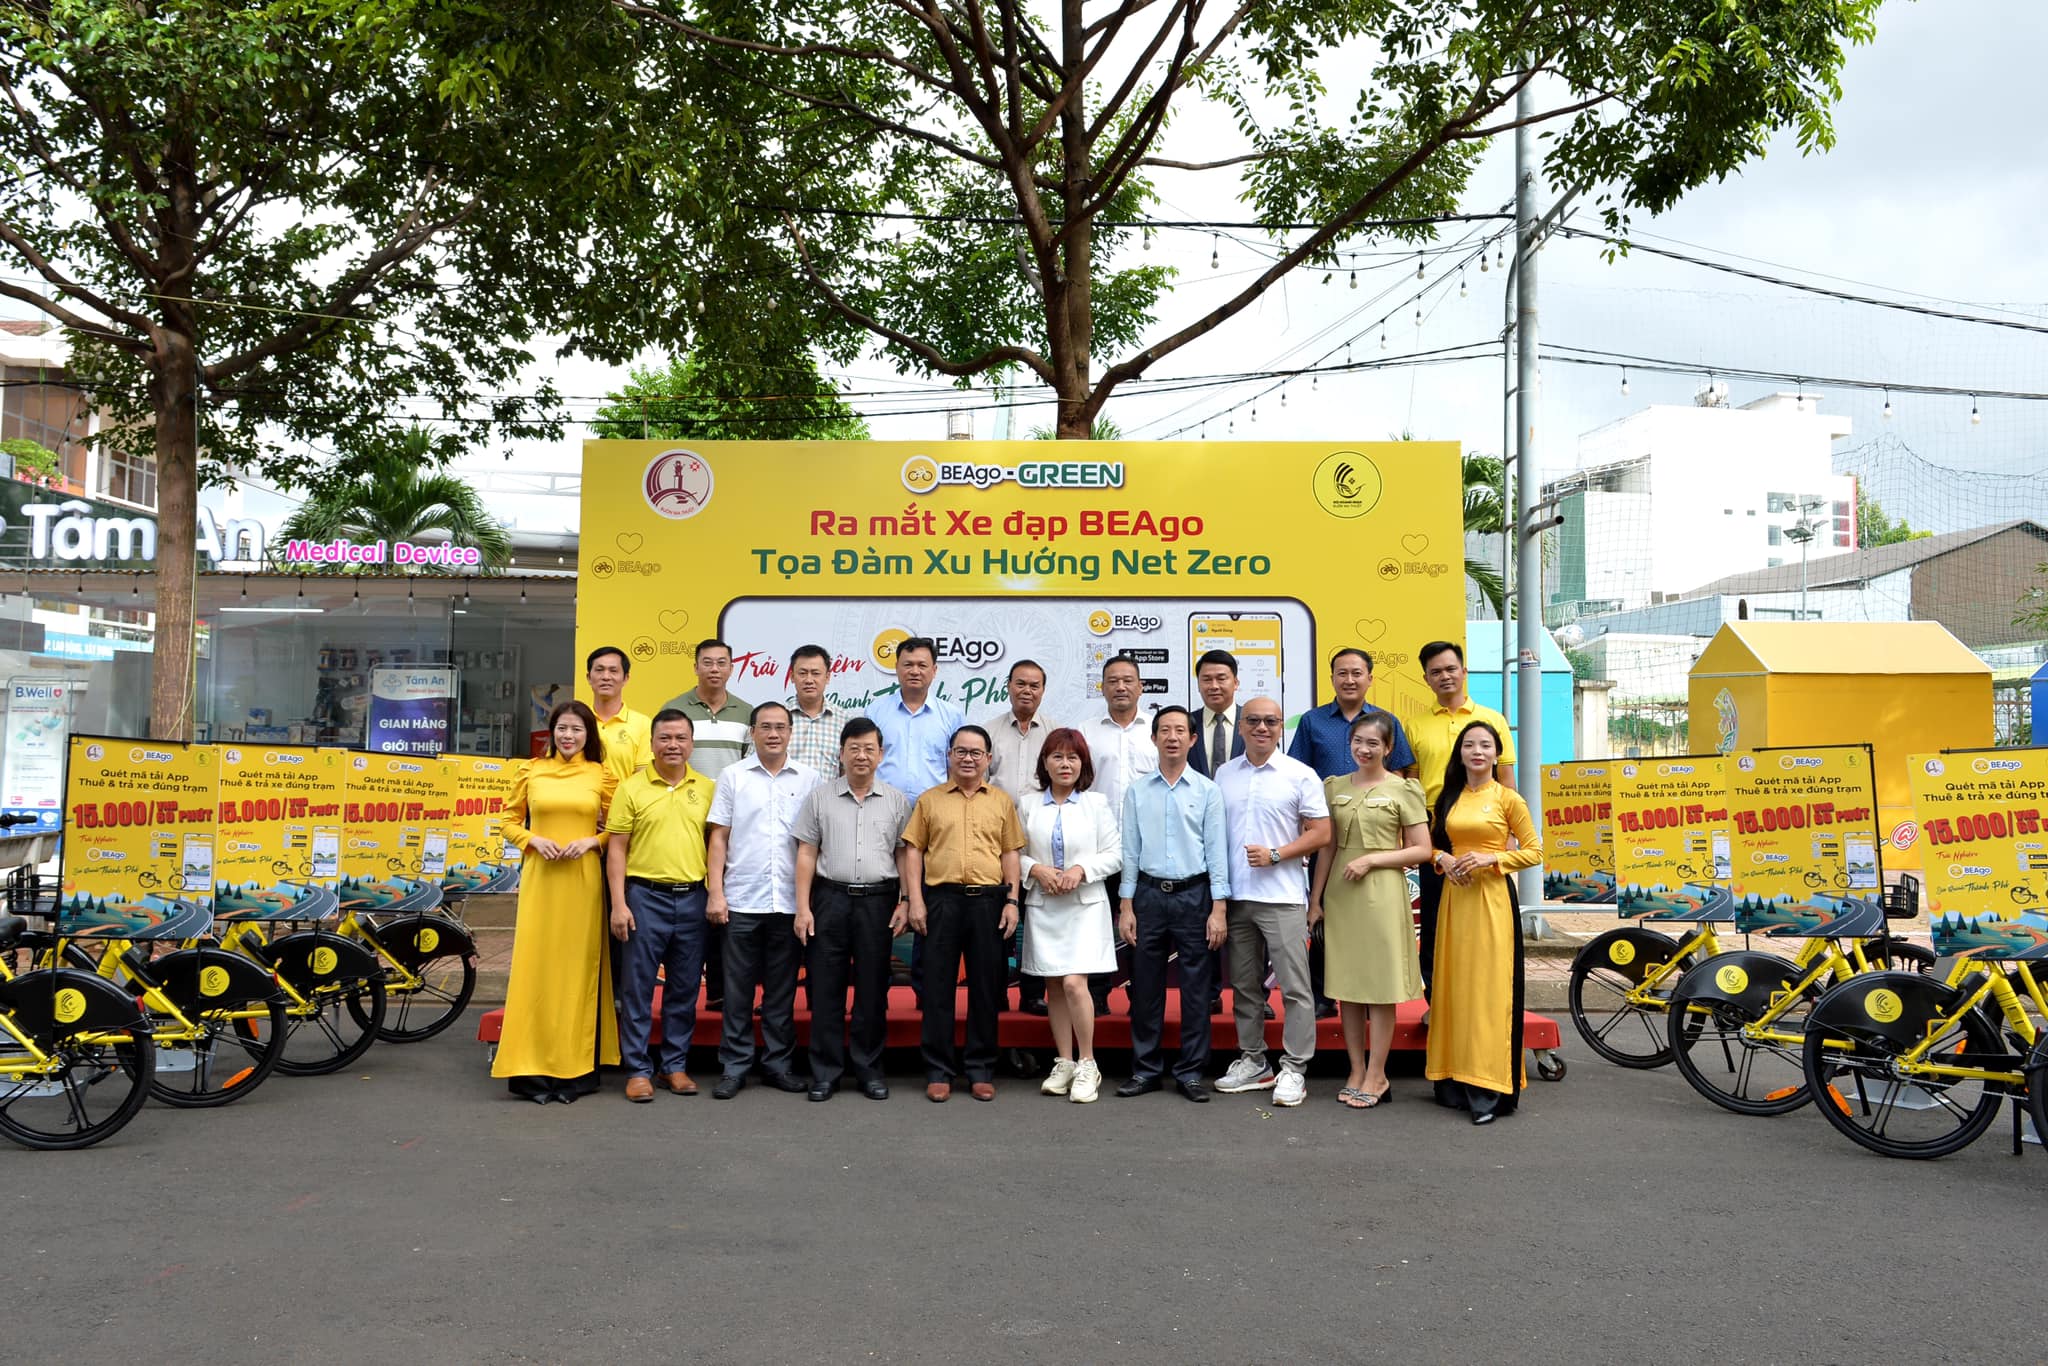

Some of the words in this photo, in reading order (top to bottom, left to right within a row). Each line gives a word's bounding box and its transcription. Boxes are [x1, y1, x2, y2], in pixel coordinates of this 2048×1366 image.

[941, 465, 1001, 484] BEAgo
[1019, 464, 1120, 484] GREEN
[811, 511, 857, 536] Ra
[870, 503, 937, 536] mắt
[946, 511, 992, 536] Xe
[1003, 511, 1068, 542] đạp
[1080, 511, 1204, 542] BEAgo
[21, 500, 157, 560] Tâm
[287, 540, 384, 563] Medical
[395, 543, 477, 564] Device
[618, 560, 661, 576] BEAgo
[752, 549, 820, 579] Tọa
[832, 547, 912, 575] Đàm
[925, 549, 970, 575] Xu
[984, 547, 1099, 580] Hướng
[1113, 549, 1176, 575] Net
[1187, 549, 1271, 575] Zero
[1404, 562, 1448, 578] BEAgo
[1115, 616, 1158, 631] BEAgo
[660, 642, 696, 660] BEAg
[1368, 651, 1408, 668] EAgo
[16, 686, 52, 698] B.Well
[380, 718, 410, 728] GIAN
[412, 716, 448, 728] HÀNG
[382, 739, 408, 752] GIỚI
[411, 740, 442, 754] THIỆU
[146, 752, 172, 762] BEAgo
[1795, 758, 1822, 768] BEAgo
[1671, 766, 1693, 774] BEAgo
[1990, 761, 2020, 770] BEAgo
[100, 769, 127, 779] Quét
[130, 770, 147, 779] mã
[150, 770, 163, 780] tải
[167, 773, 189, 782] App
[283, 772, 295, 780] tải
[298, 773, 318, 781] App
[1754, 778, 1780, 786] Quét
[1802, 776, 1816, 784] tải
[1819, 776, 1842, 785] App
[79, 778, 105, 788] Thuê
[119, 779, 134, 788] trả
[152, 781, 180, 792] đúng
[183, 784, 208, 794] trạm
[220, 779, 243, 787] Thuê
[256, 780, 268, 788] trả
[286, 780, 310, 790] đúng
[313, 783, 335, 791] trạm
[364, 776, 385, 784] Quét
[404, 778, 416, 786] tải
[416, 781, 434, 789] App
[1636, 782, 1658, 790] Quét
[1945, 782, 1975, 791] Quét
[2000, 780, 2016, 789] tải
[2020, 780, 2046, 789] App
[346, 783, 366, 791] Thuê
[378, 785, 390, 793] trả
[404, 787, 426, 796] đúng
[428, 790, 448, 798] trạm
[1680, 790, 1704, 798] đúng
[1735, 786, 1760, 795] Thuê
[1774, 786, 1788, 794] trả
[1806, 786, 1834, 795] đúng
[1836, 786, 1862, 794] trạm
[1924, 792, 1954, 802] Thuê
[1968, 791, 1984, 800] trả
[2006, 790, 2037, 800] đúng
[1924, 810, 2014, 846] 15.000/
[1964, 866, 1990, 876] BEAgo
